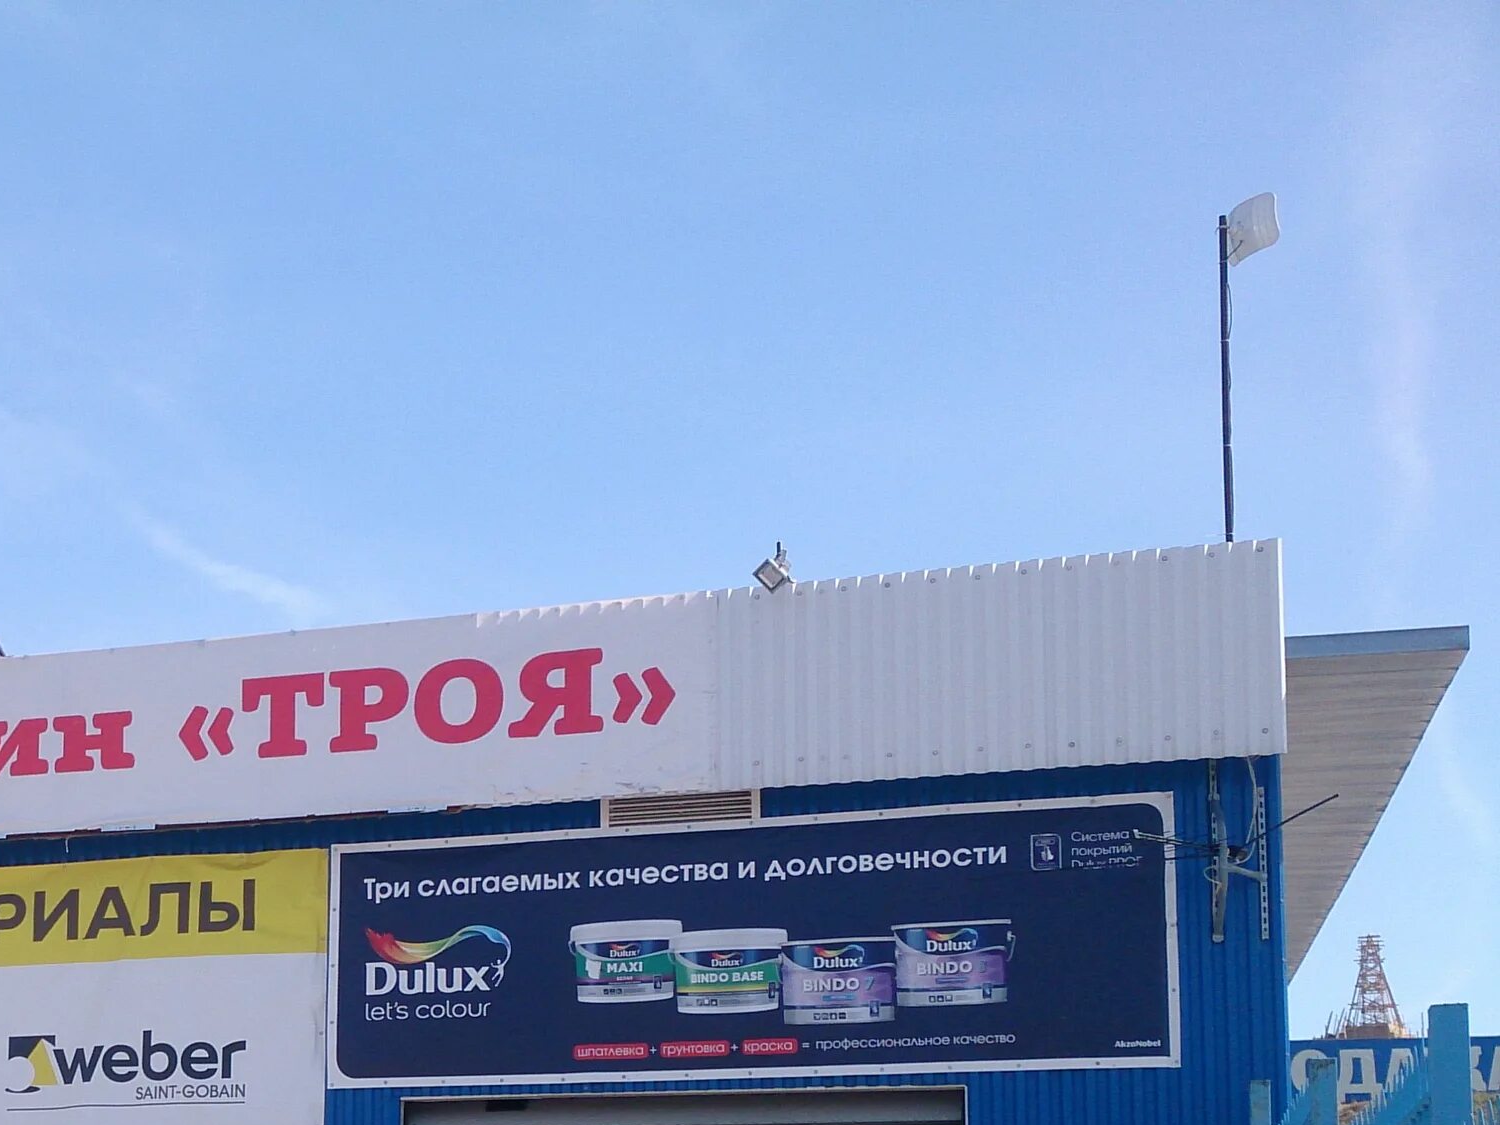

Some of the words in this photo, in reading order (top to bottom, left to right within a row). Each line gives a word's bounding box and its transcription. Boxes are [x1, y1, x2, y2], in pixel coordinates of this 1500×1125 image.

[178, 647, 675, 761] «ТРОЯ»
[1071, 830, 1130, 842] Система
[1071, 843, 1133, 857] покрытий
[363, 877, 410, 904] Три
[417, 870, 581, 897] слагаемых
[588, 859, 729, 888] качества
[738, 860, 756, 879] и
[763, 845, 1008, 882] долговечности
[609, 948, 637, 958] Dulux
[926, 939, 971, 953] Dulux
[606, 961, 644, 974] MAXI
[710, 958, 740, 968] Dulux
[813, 956, 859, 970] Dulux
[916, 960, 973, 976] BINDO
[364, 961, 492, 996] Dulux
[690, 972, 728, 984] BINDO
[732, 971, 764, 982] BASE
[802, 977, 860, 993] BINDO
[364, 1001, 410, 1022] let's
[414, 1000, 492, 1021] colour
[576, 1045, 645, 1058] шпатлевка
[662, 1042, 725, 1058] грунтовка
[743, 1040, 793, 1054] краска
[815, 1035, 951, 1052] профессиональное
[953, 1033, 1017, 1046] качество
[53, 1029, 247, 1085] weber
[135, 1082, 247, 1101] SAINT-GOBAIN
